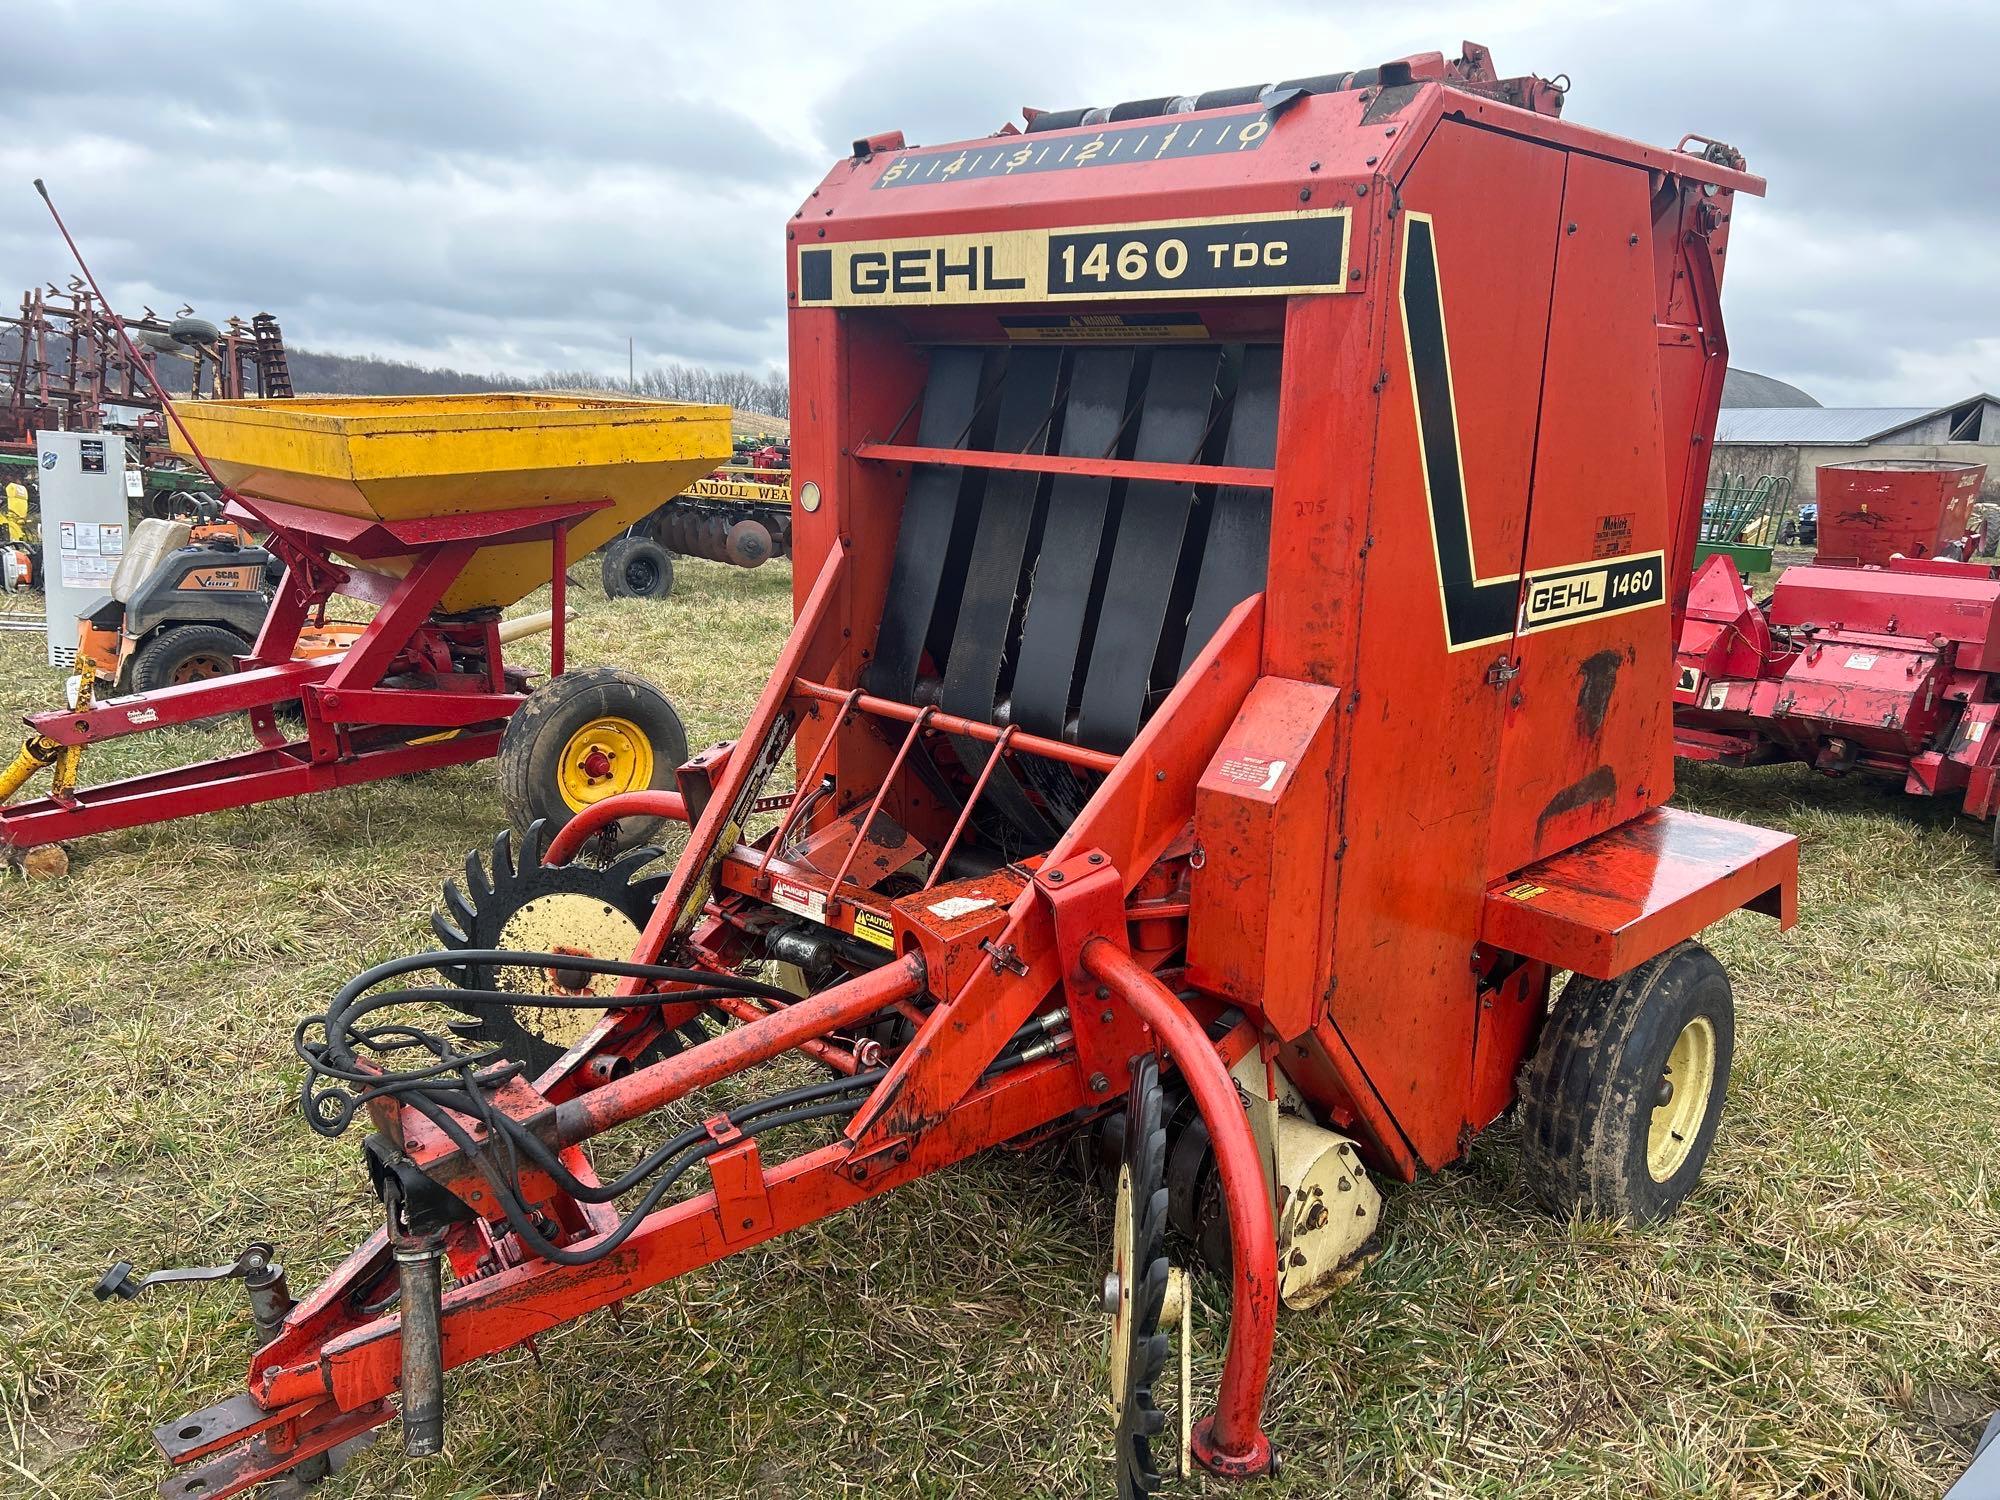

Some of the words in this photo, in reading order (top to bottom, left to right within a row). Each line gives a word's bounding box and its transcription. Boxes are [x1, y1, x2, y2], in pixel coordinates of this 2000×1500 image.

[883, 164, 906, 181] 5
[943, 158, 965, 175] 4
[1007, 150, 1032, 166] 3
[1075, 141, 1104, 158] 2
[1239, 121, 1268, 141] 0
[850, 245, 1026, 294] GEHL
[1063, 239, 1189, 284] 1460
[1207, 241, 1288, 268] TDC
[684, 483, 748, 496] ANDOLL
[759, 488, 791, 500] WEA
[215, 571, 239, 579] SCAG
[1532, 581, 1598, 613] GEHL
[1612, 569, 1652, 598] 1460
[782, 883, 808, 899] DANGER
